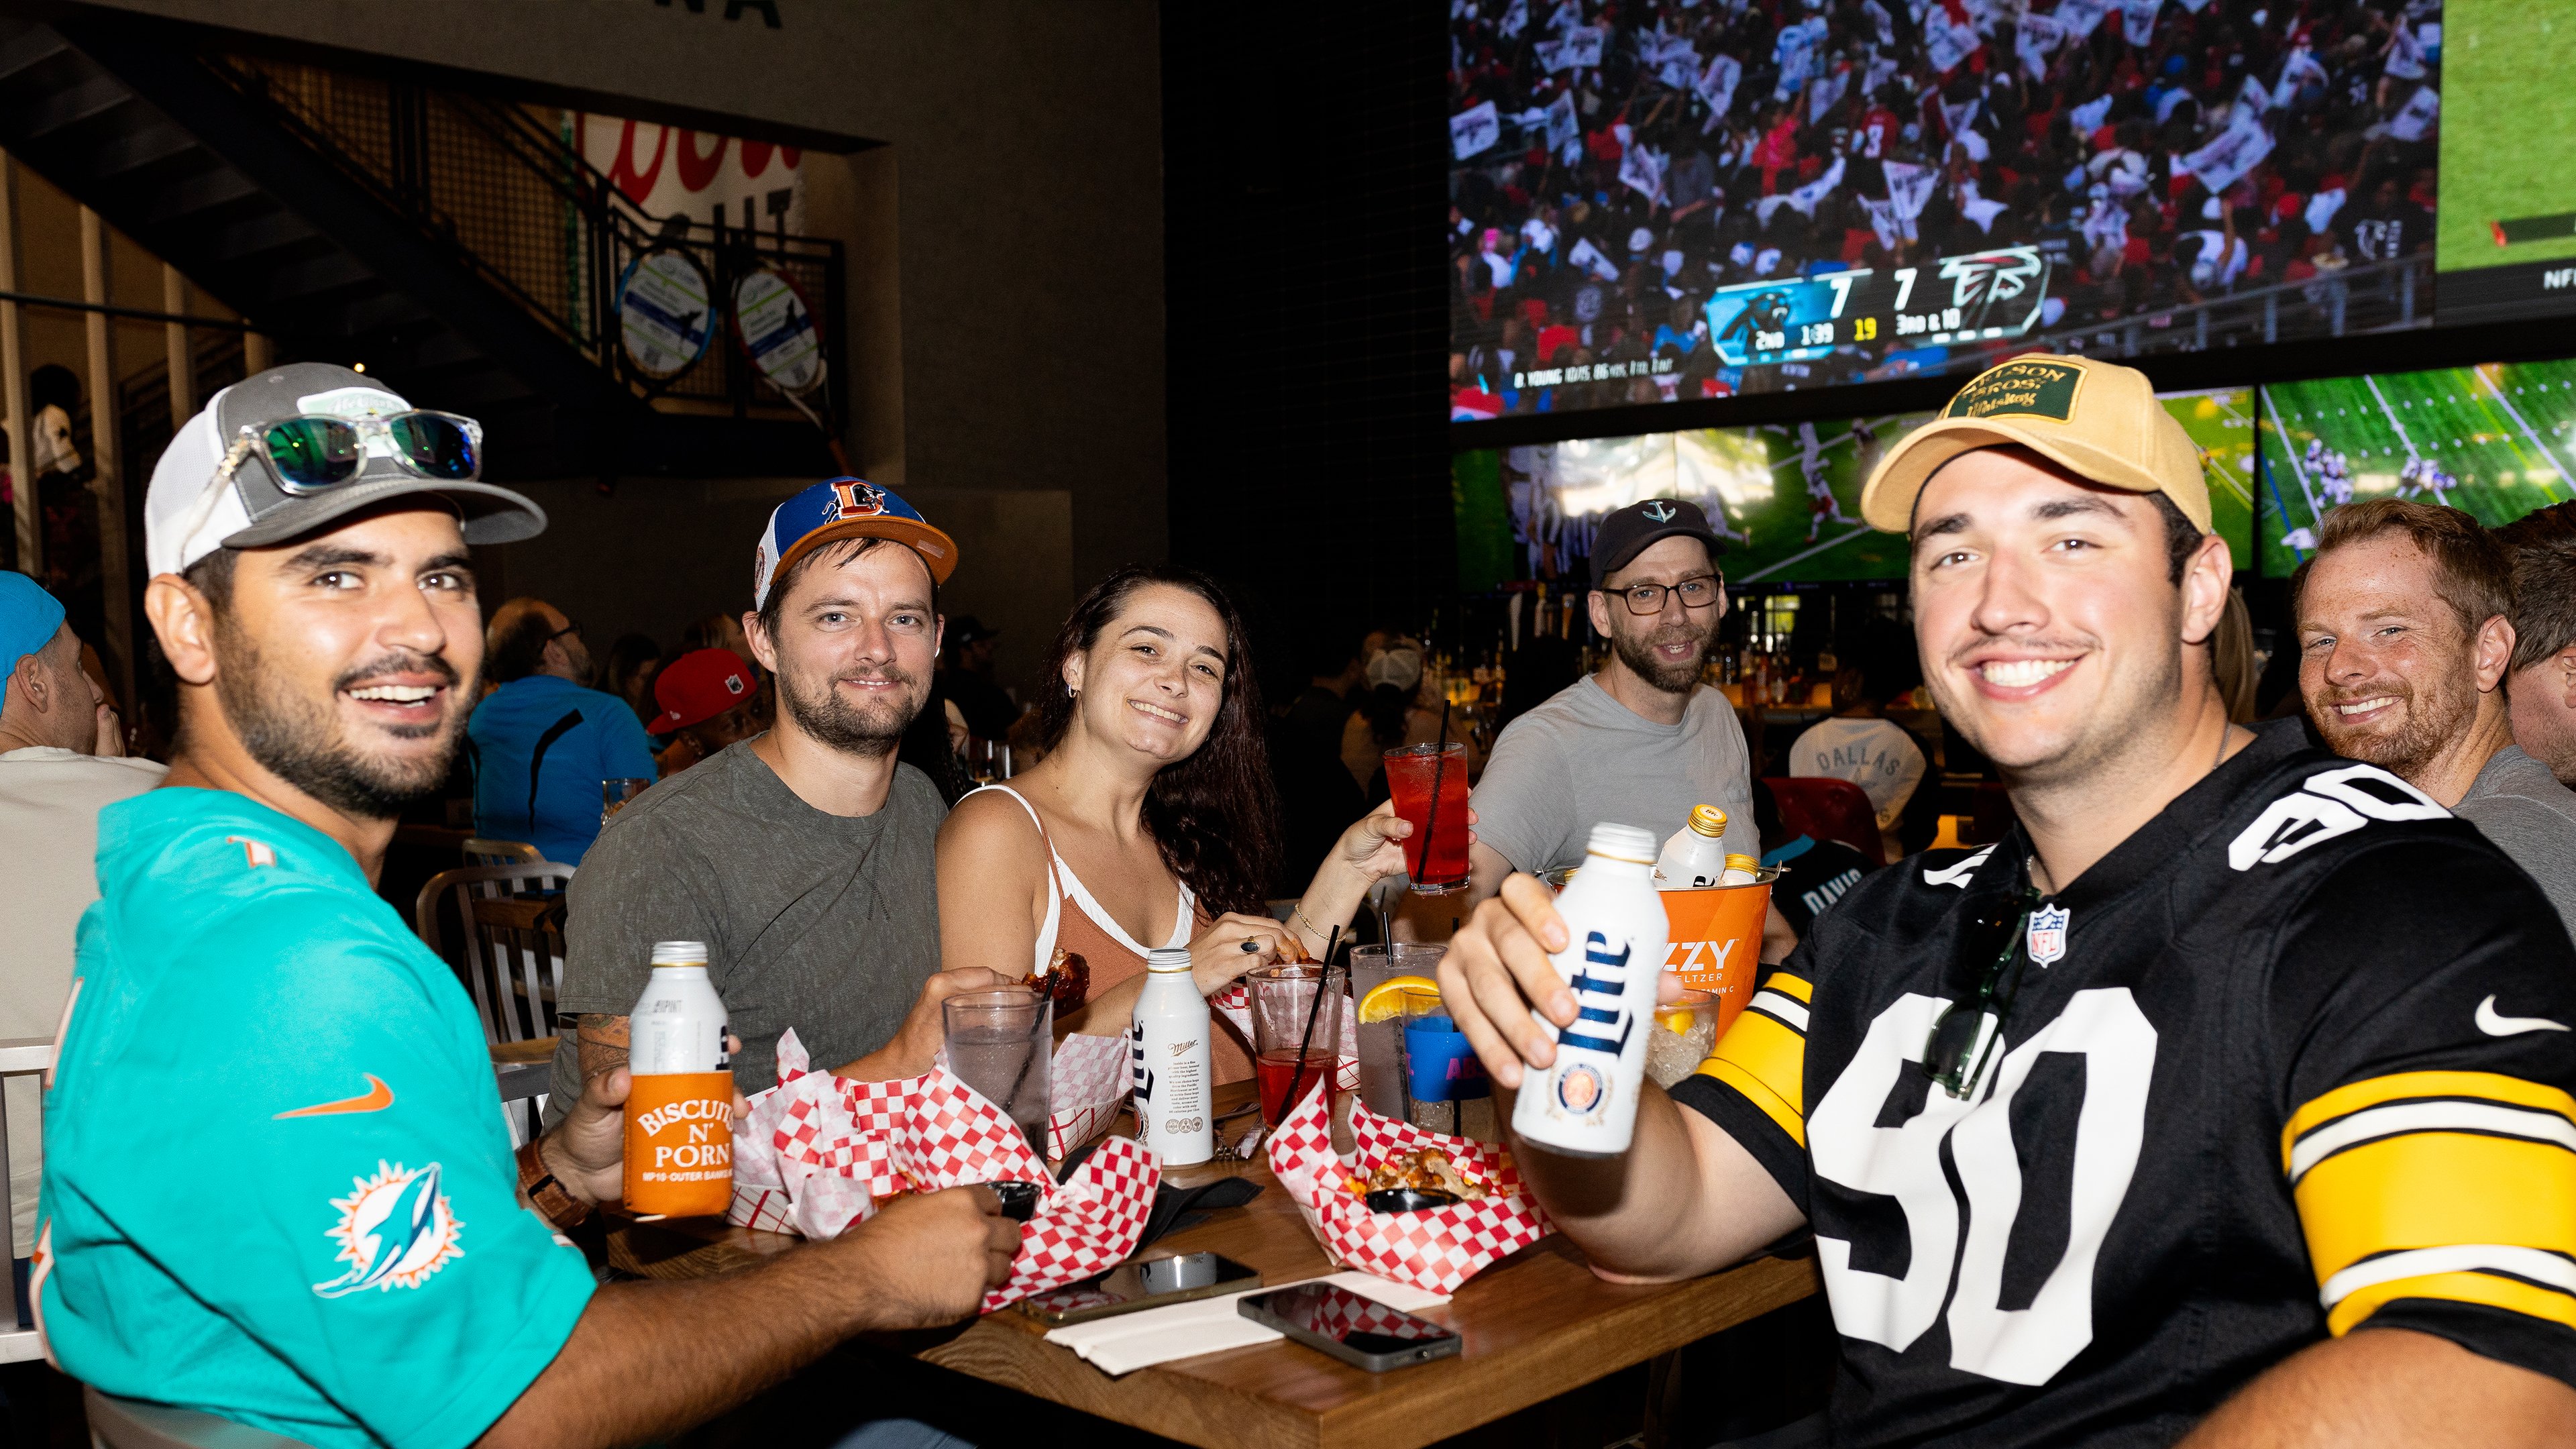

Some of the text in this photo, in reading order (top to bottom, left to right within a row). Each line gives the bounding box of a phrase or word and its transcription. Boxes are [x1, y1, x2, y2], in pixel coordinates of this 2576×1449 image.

[1894, 268, 1917, 311] 7
[2543, 268, 2576, 290] NF
[1830, 276, 1852, 319] 7
[1855, 317, 1876, 341] 19
[1928, 313, 1941, 331] &
[1942, 308, 1961, 329] 10
[1756, 331, 1784, 350] 2ND
[1527, 368, 1562, 387] YOUNG
[1816, 746, 1900, 775] DALLAS
[1557, 930, 1633, 1059] Lite
[1168, 1039, 1198, 1057] Miller
[655, 1142, 730, 1168] PORN
[1807, 987, 2157, 1386] 90
